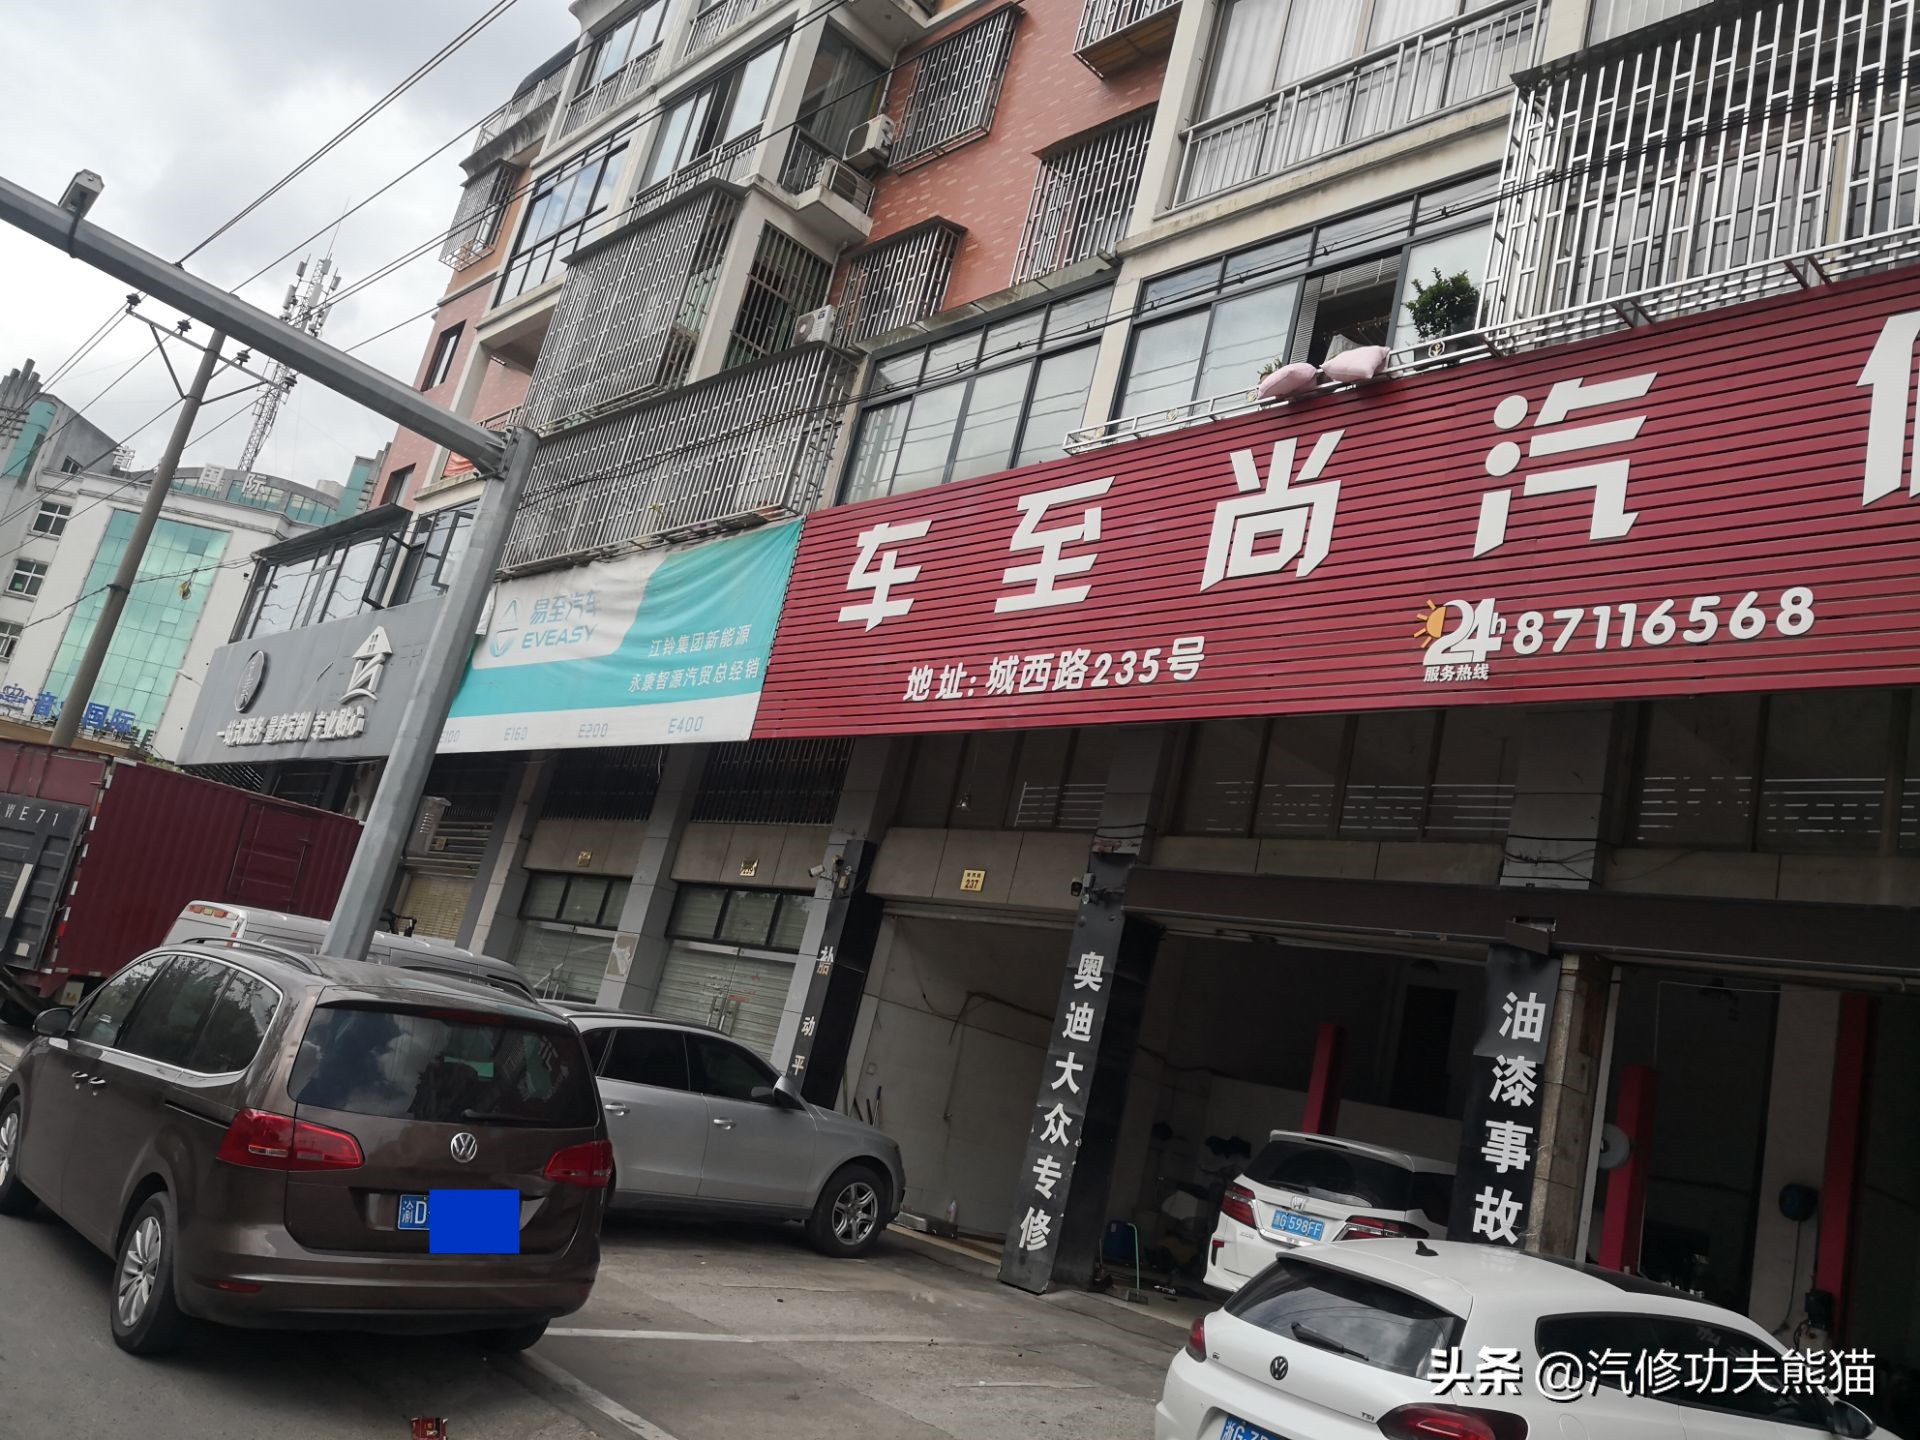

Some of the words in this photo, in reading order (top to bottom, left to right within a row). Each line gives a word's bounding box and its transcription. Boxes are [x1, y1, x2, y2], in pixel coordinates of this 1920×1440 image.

[529, 591, 600, 625] 易至汽车
[1513, 586, 1815, 655] 87116568
[521, 625, 598, 650] EVEASY
[648, 623, 752, 658] 江铃集团新能源
[628, 657, 760, 693] 永康智源汽贸总经销
[1424, 663, 1490, 683] 服务热线
[577, 722, 609, 739] E200
[668, 715, 704, 735] E400
[1018, 951, 1105, 1251] 奥迪大众专修
[1472, 991, 1547, 1245] 油漆事故
